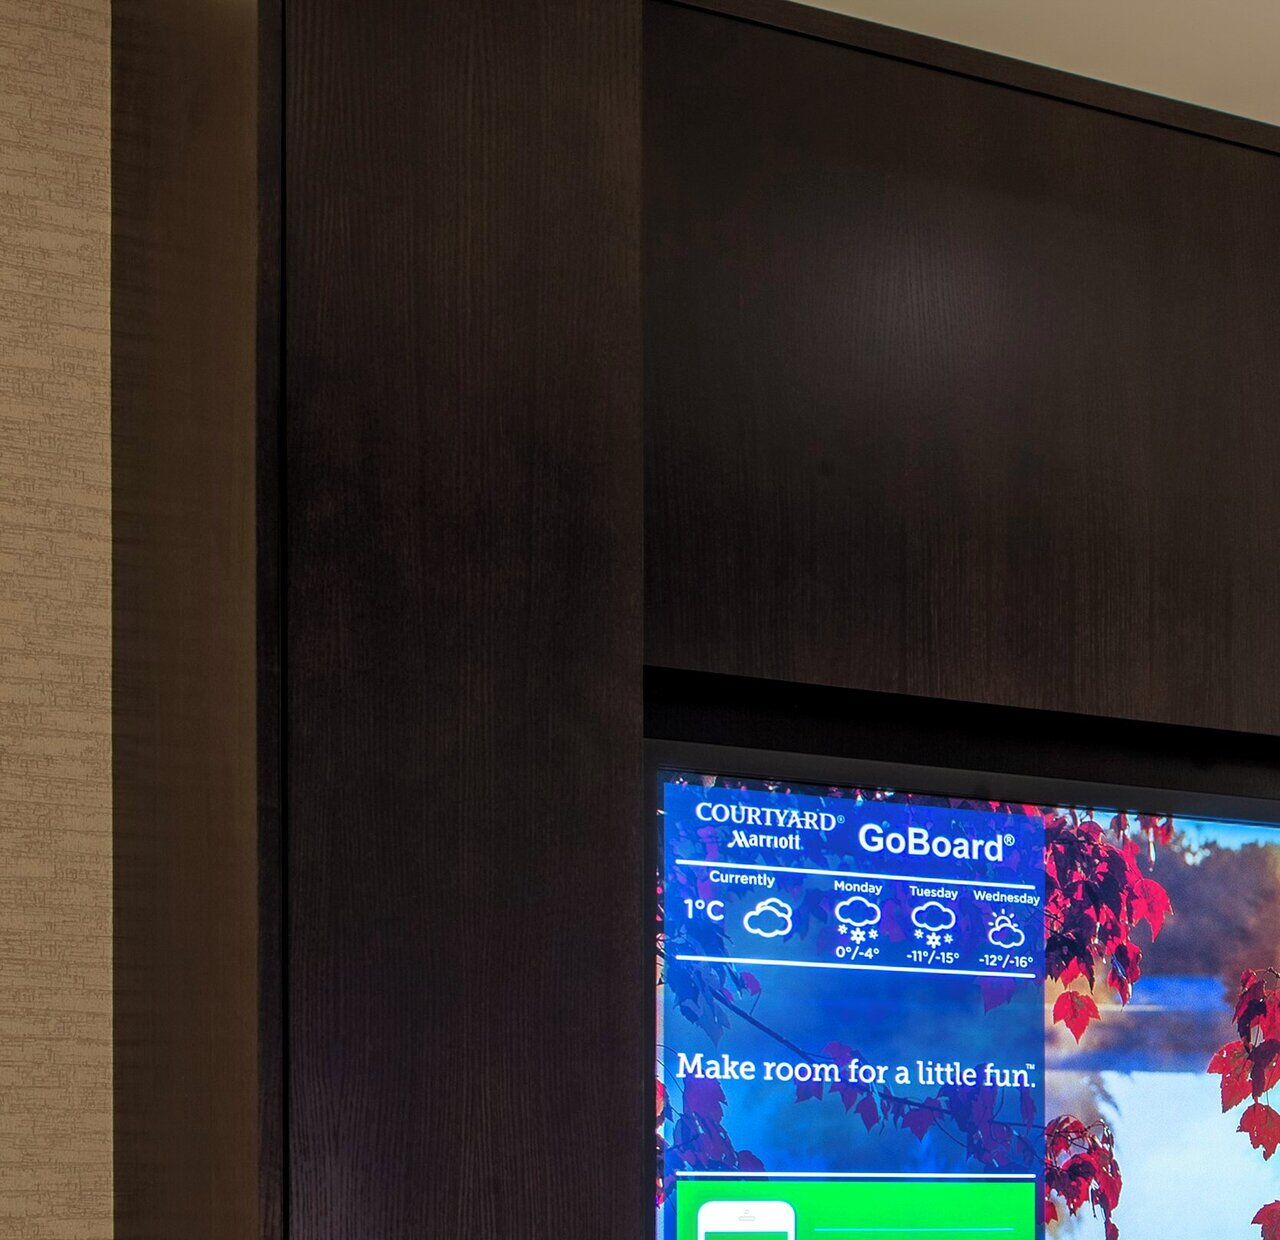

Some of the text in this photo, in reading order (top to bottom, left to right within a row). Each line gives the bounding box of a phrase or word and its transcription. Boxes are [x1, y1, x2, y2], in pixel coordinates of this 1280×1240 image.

[727, 830, 801, 850] Marriott
[709, 870, 776, 889] Currently
[834, 880, 883, 895] Monday
[909, 885, 958, 900] Tuesday
[973, 890, 1040, 906] Wednesday
[683, 898, 725, 922] 1°C
[835, 946, 880, 961] 0°/-4°
[675, 1052, 756, 1081] Make
[763, 1061, 841, 1083] room
[848, 1058, 889, 1084] for
[894, 1065, 911, 1085] a
[916, 1060, 977, 1086] little
